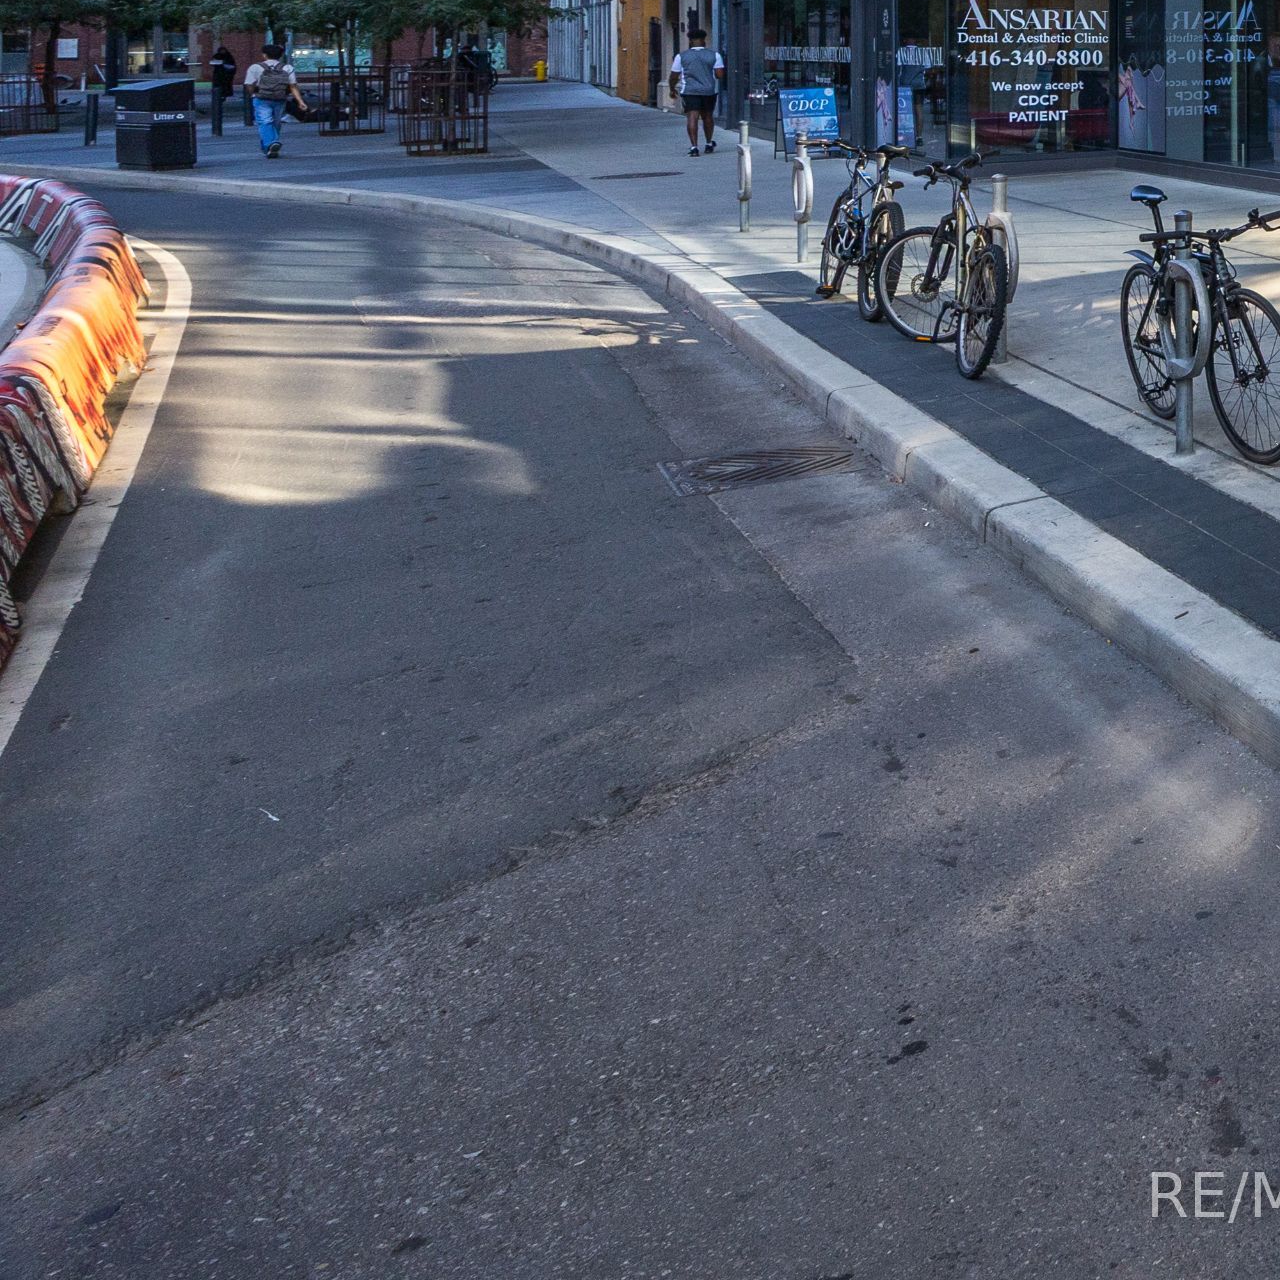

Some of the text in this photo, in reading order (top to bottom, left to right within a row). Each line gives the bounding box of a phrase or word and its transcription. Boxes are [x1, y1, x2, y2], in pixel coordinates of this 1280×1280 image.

[957, 33, 1109, 44] Dental & Aesthetic Clinic
[965, 50, 1103, 66] 416-340-8800
[992, 80, 1084, 93] We now accept
[788, 99, 829, 111] CDCP
[1018, 95, 1059, 106] CDCP
[153, 113, 175, 121] Litter
[1009, 110, 1069, 122] PATIENT
